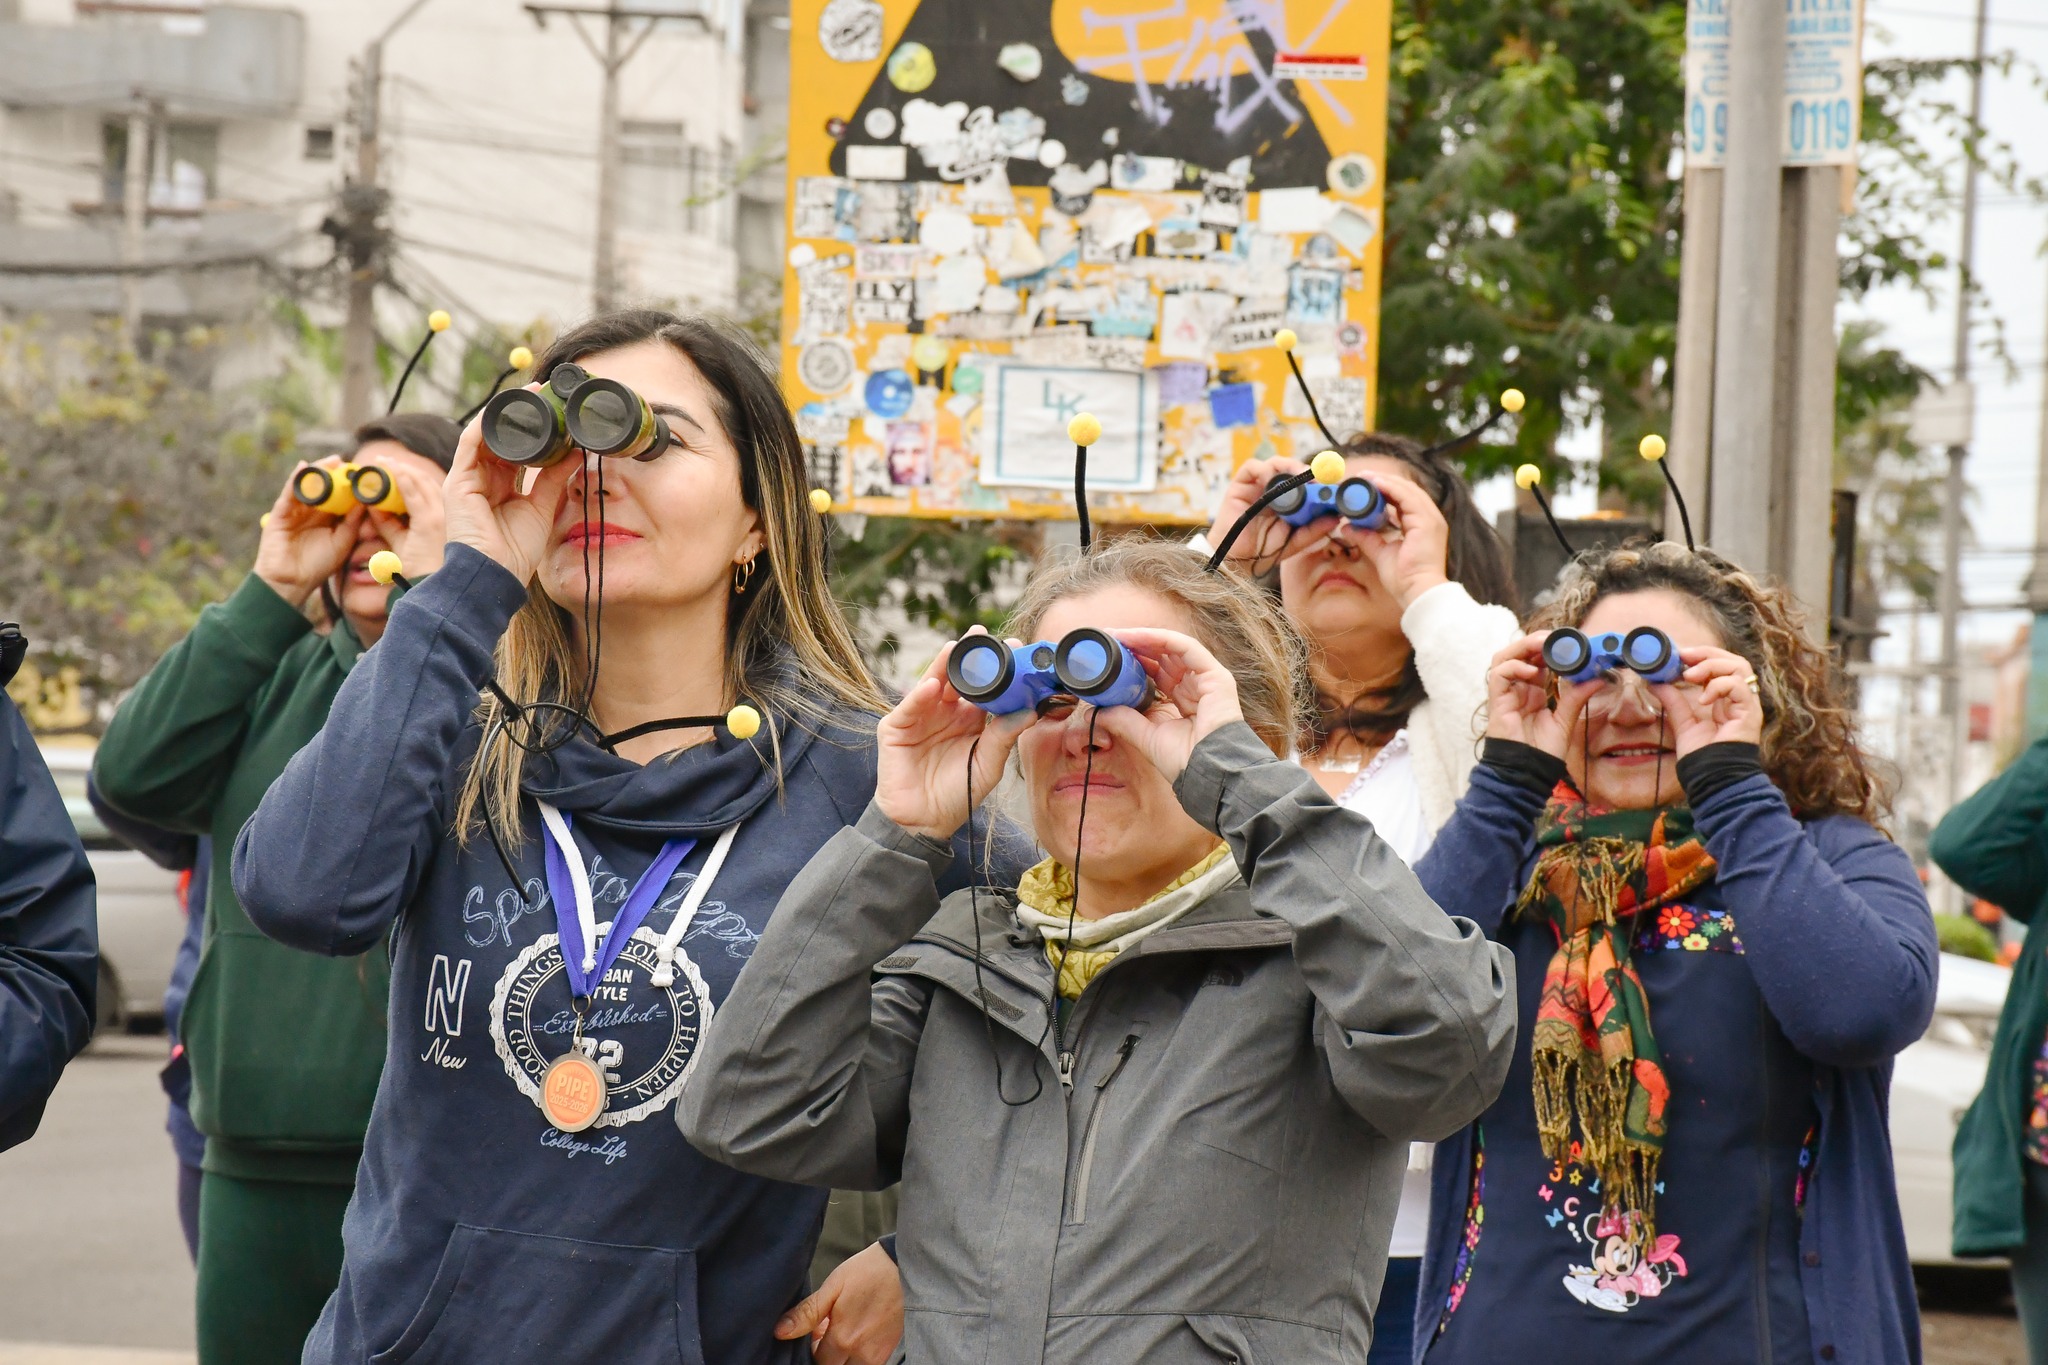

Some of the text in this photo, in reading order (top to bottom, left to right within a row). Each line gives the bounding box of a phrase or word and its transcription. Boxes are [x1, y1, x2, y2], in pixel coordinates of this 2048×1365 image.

[1790, 99, 1850, 150] 0119
[507, 948, 563, 1022] THINGS
[602, 968, 634, 985] BAN
[424, 954, 472, 1037] N
[592, 986, 630, 1003] TYLE
[675, 984, 696, 1017] TO
[420, 1036, 468, 1070] New
[635, 1026, 697, 1101] HAPPEN
[550, 1093, 589, 1114] 2025-2026
[556, 1073, 591, 1102] PIPE
[540, 1127, 628, 1166] College Life
